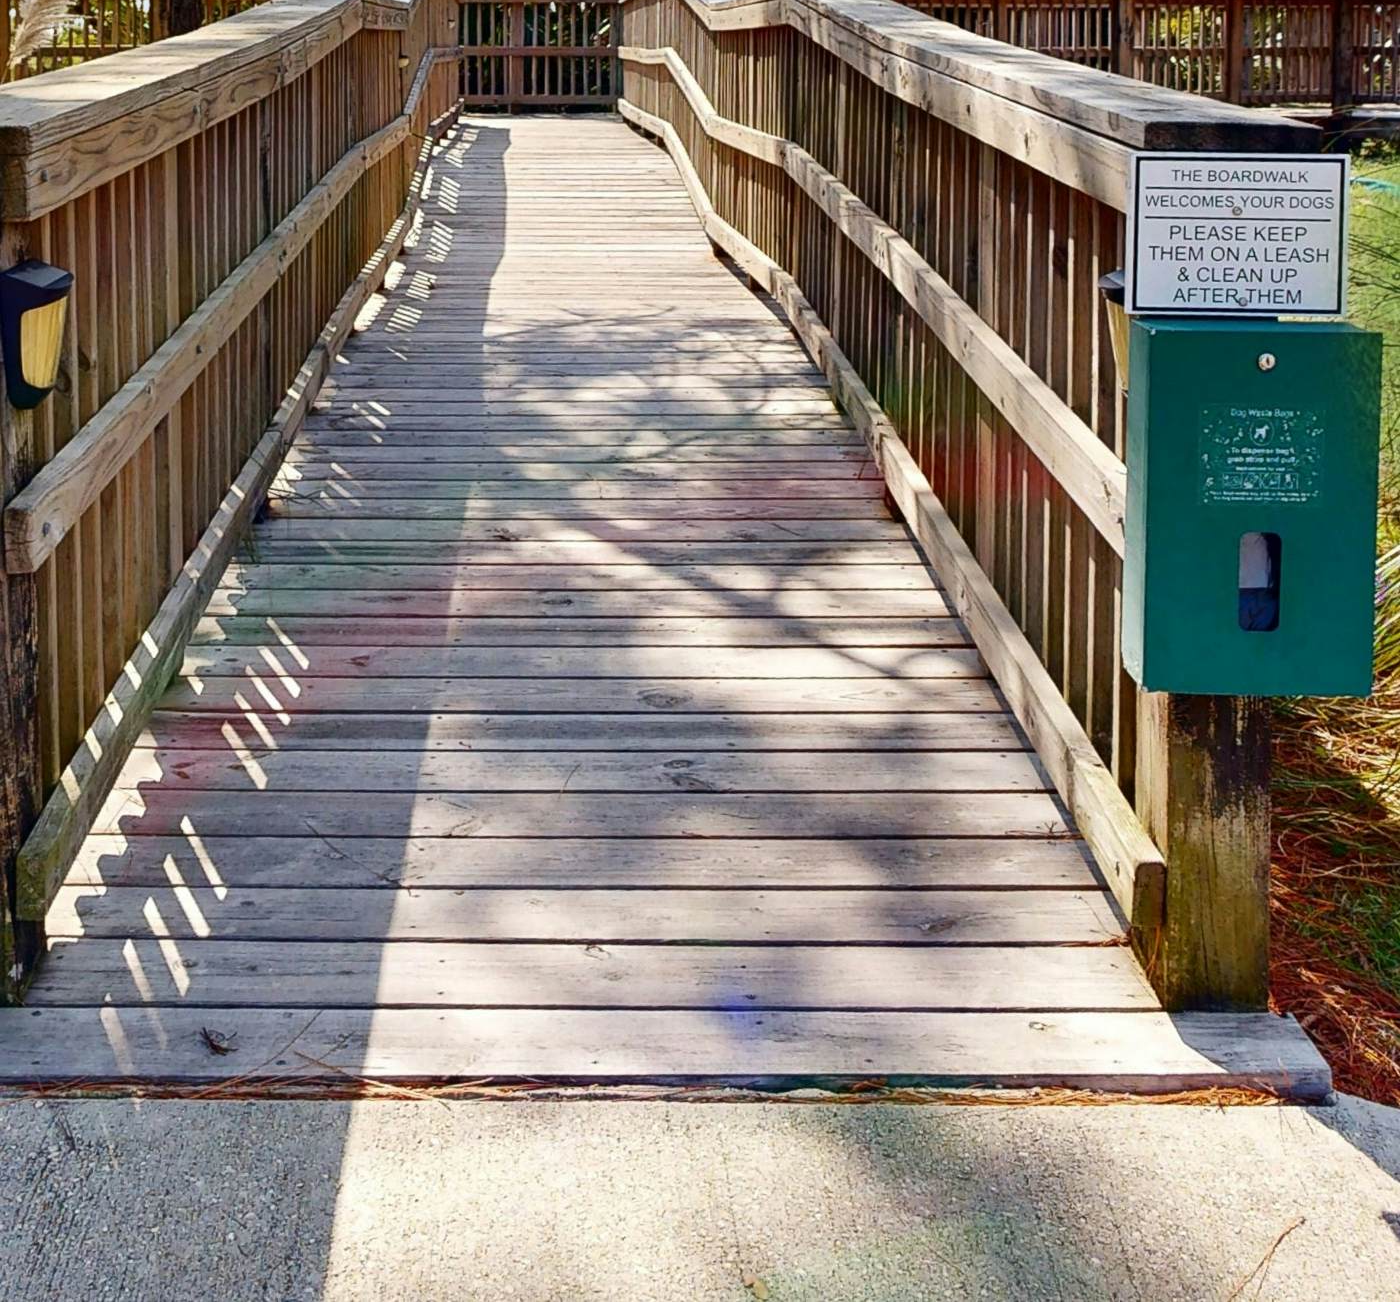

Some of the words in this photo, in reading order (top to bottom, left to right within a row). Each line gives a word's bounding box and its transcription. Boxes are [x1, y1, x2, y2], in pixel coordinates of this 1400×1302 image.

[1171, 169, 1202, 182] THE
[1208, 170, 1309, 183] BOARDWALK
[1145, 195, 1234, 209] WELCOMES
[1240, 196, 1284, 209] YOUR
[1289, 196, 1335, 210] DOGS
[1169, 225, 1247, 241] PLEASE
[1254, 226, 1308, 242] KEEP
[1148, 245, 1203, 262] THEM
[1211, 246, 1240, 262] ON
[1245, 247, 1258, 262] A
[1264, 247, 1330, 263] LEASH
[1177, 266, 1190, 282] &
[1196, 267, 1263, 283] CLEAN
[1270, 268, 1297, 283] UP
[1172, 288, 1241, 303] AFTER
[1245, 288, 1302, 304] THEM
[1230, 408, 1246, 418] Dog
